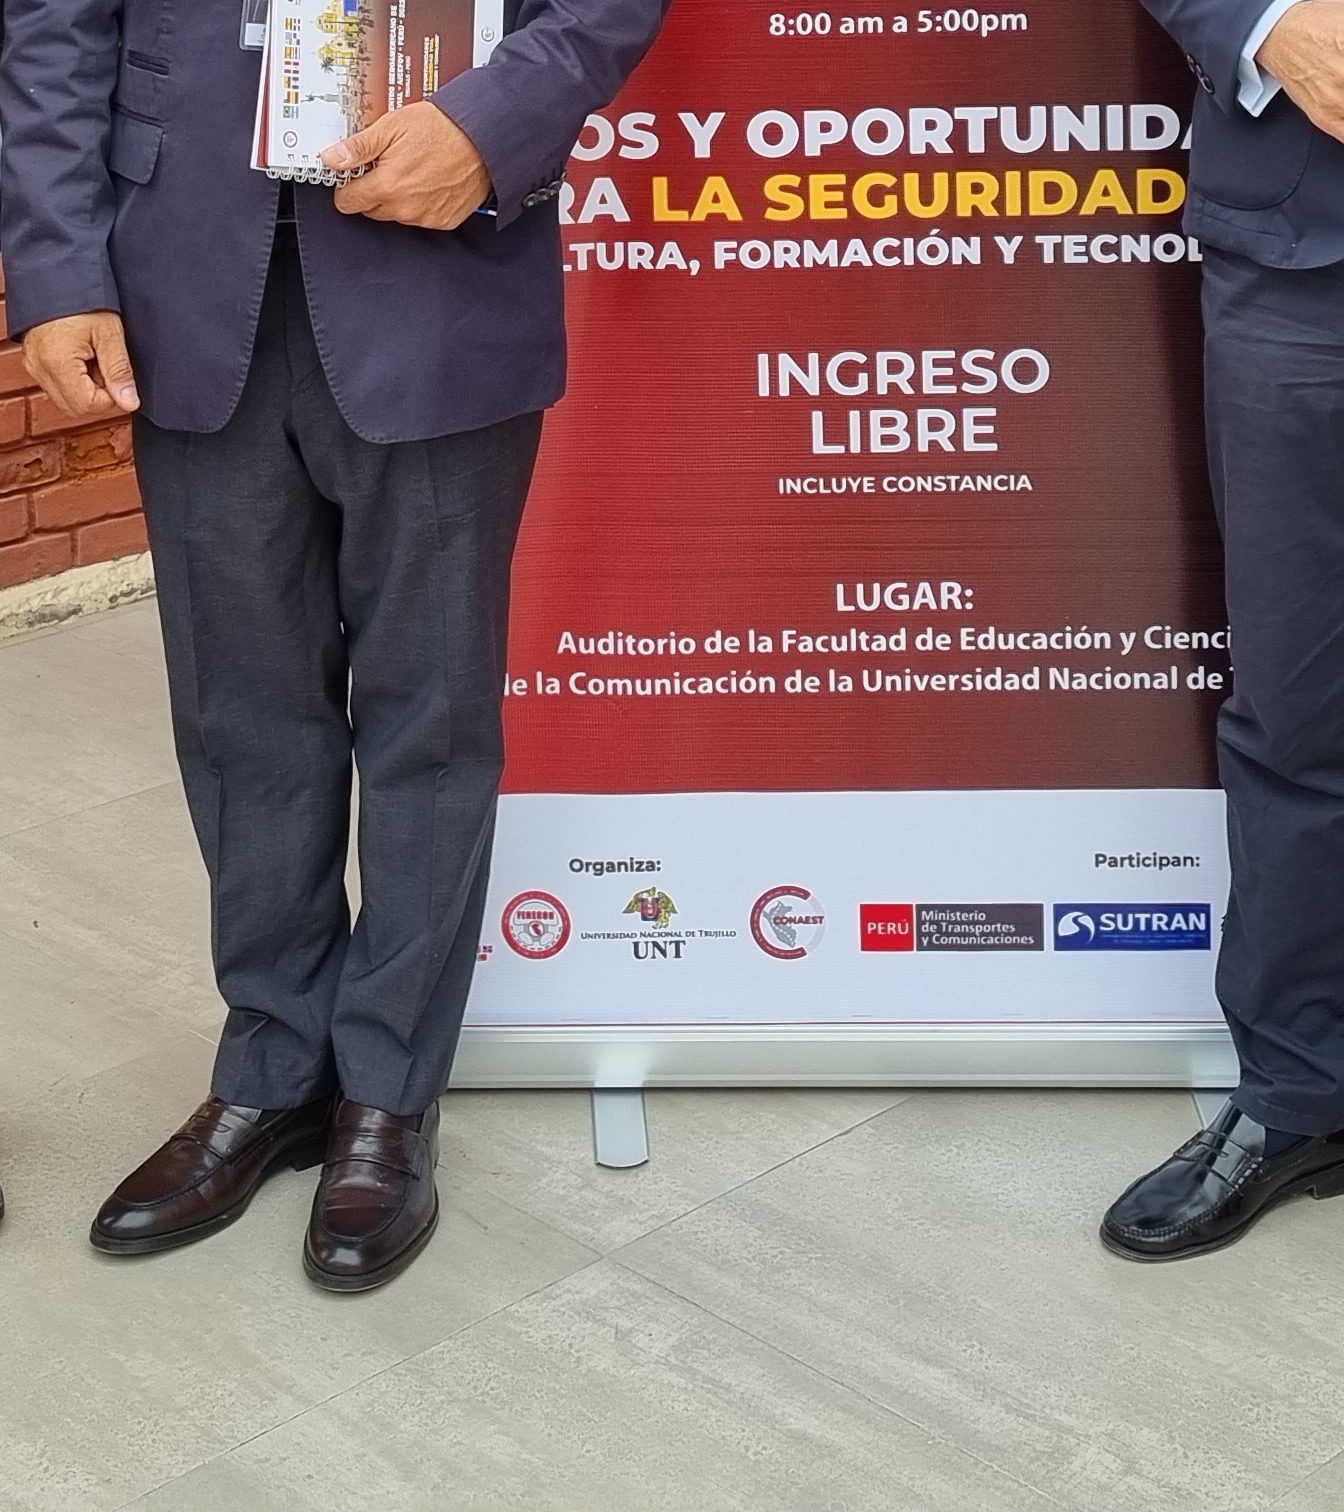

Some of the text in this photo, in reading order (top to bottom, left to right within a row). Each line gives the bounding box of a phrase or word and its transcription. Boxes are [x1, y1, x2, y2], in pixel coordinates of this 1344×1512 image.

[768, 8, 1029, 39] 8:00 am a 5:00pm
[677, 111, 726, 159] Y
[652, 176, 744, 222] LA
[763, 168, 1187, 222] SEGURIDAD
[713, 229, 981, 270] FORMACIÓN
[999, 235, 1025, 265] Y
[757, 348, 1050, 398] INGRESO
[810, 407, 1000, 455] LIBRE
[777, 474, 1033, 495] INCLUYE CONSTANCIA
[836, 582, 974, 611] LUGAR:
[557, 630, 697, 656] Auditorio
[704, 629, 741, 654] de
[748, 628, 773, 653] la
[782, 627, 907, 653] Facultad
[915, 626, 952, 651] de
[960, 624, 1111, 651] Educación
[1120, 631, 1137, 656] y
[536, 671, 561, 695] la
[569, 669, 776, 696] Comunicación
[784, 668, 821, 694] de
[829, 668, 854, 693] la
[862, 666, 1040, 693] Universidad
[1048, 666, 1178, 691] Nacional
[1186, 665, 1224, 690] de
[568, 856, 663, 876] Organiza:
[1094, 852, 1201, 871] Participan:
[772, 916, 825, 926] CONAEST
[921, 910, 987, 922] Ministerio
[1099, 913, 1206, 931] SUTRAN
[867, 919, 909, 935] PERÚ
[921, 922, 1016, 935] de Transportes
[632, 940, 686, 960] UNT
[921, 934, 1035, 947] y Comunicaciones
